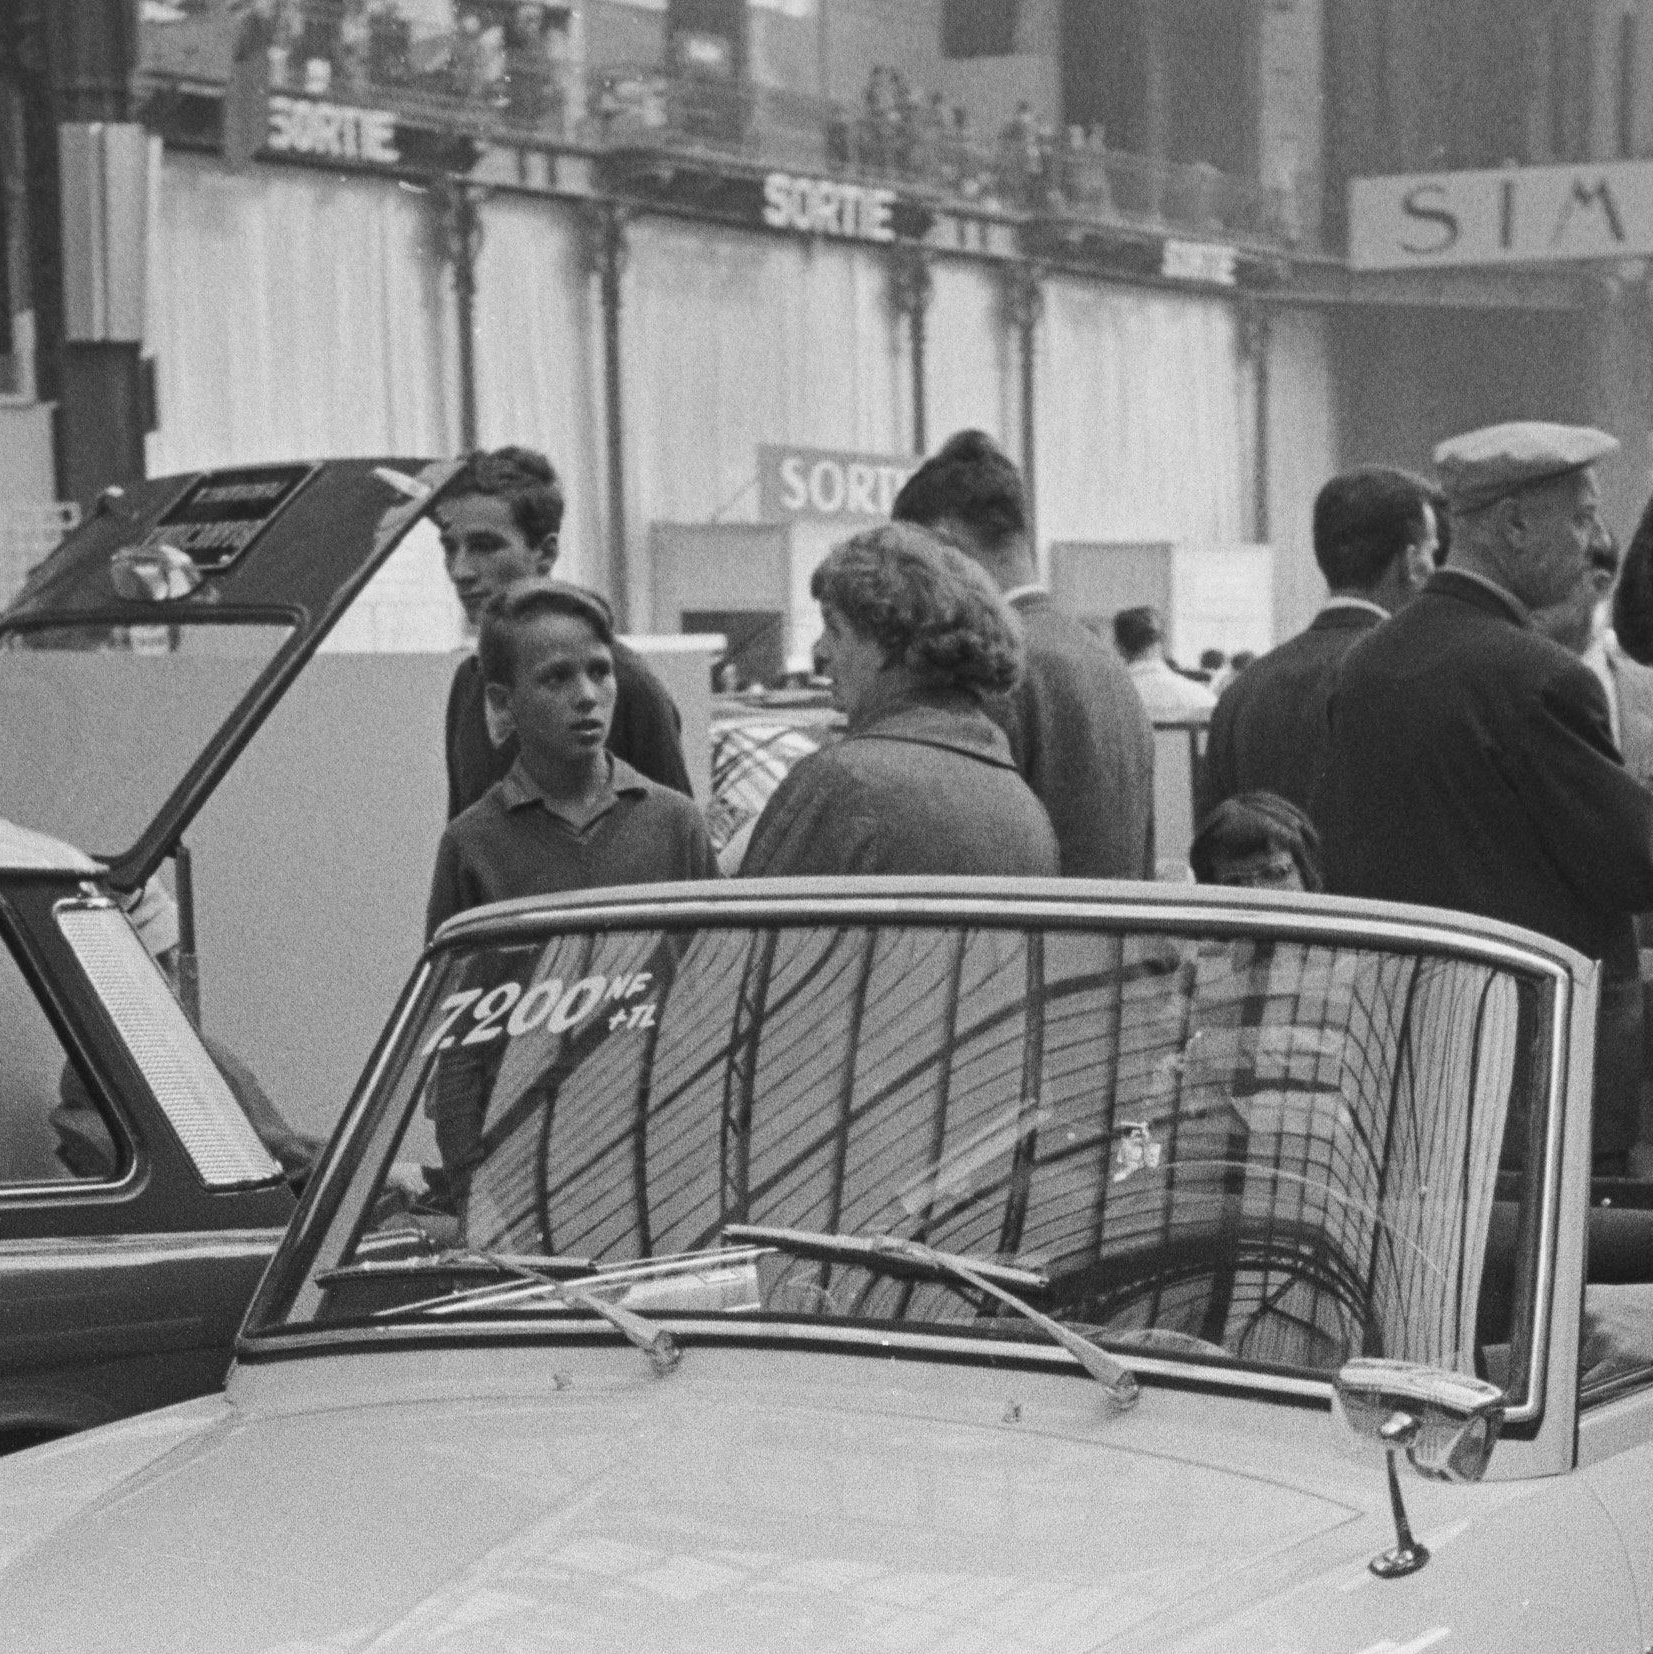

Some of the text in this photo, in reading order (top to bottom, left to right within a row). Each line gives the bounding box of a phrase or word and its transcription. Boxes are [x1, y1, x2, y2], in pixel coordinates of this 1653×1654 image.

[267, 95, 401, 164] SORTIE
[762, 172, 898, 243] SORTIE
[779, 456, 913, 515] SORT
[603, 971, 653, 1003] NF
